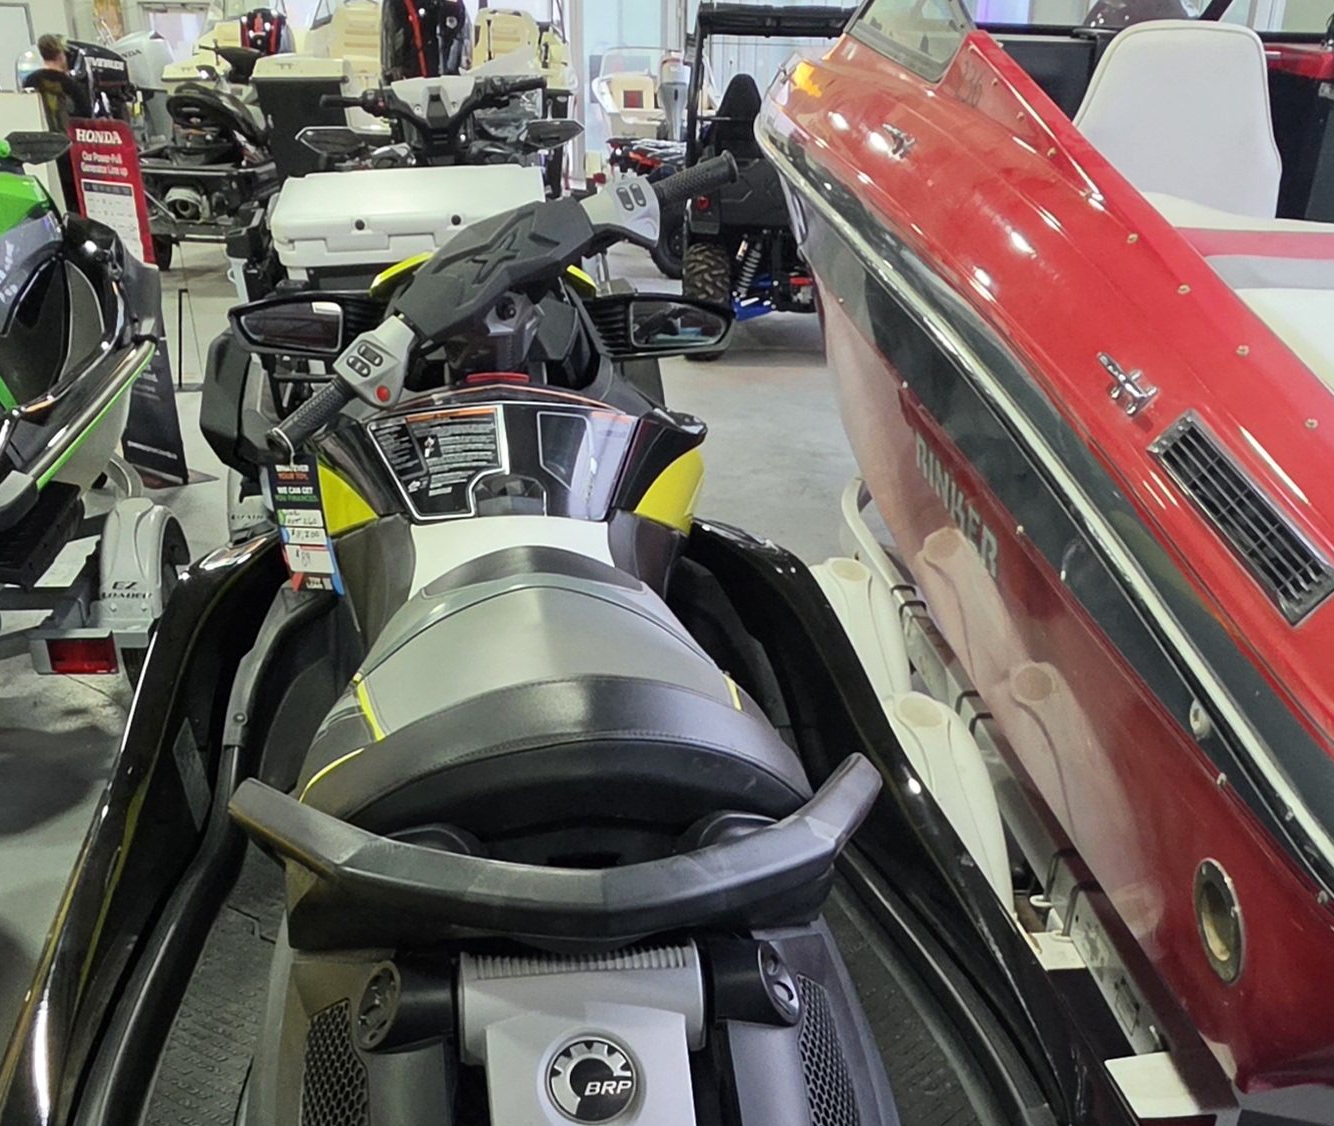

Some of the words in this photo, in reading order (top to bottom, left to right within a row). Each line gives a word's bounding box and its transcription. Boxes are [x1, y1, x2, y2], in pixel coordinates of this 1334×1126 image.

[75, 128, 123, 145] HONDA
[916, 429, 999, 579] RINKER
[584, 1080, 633, 1096] BRP
